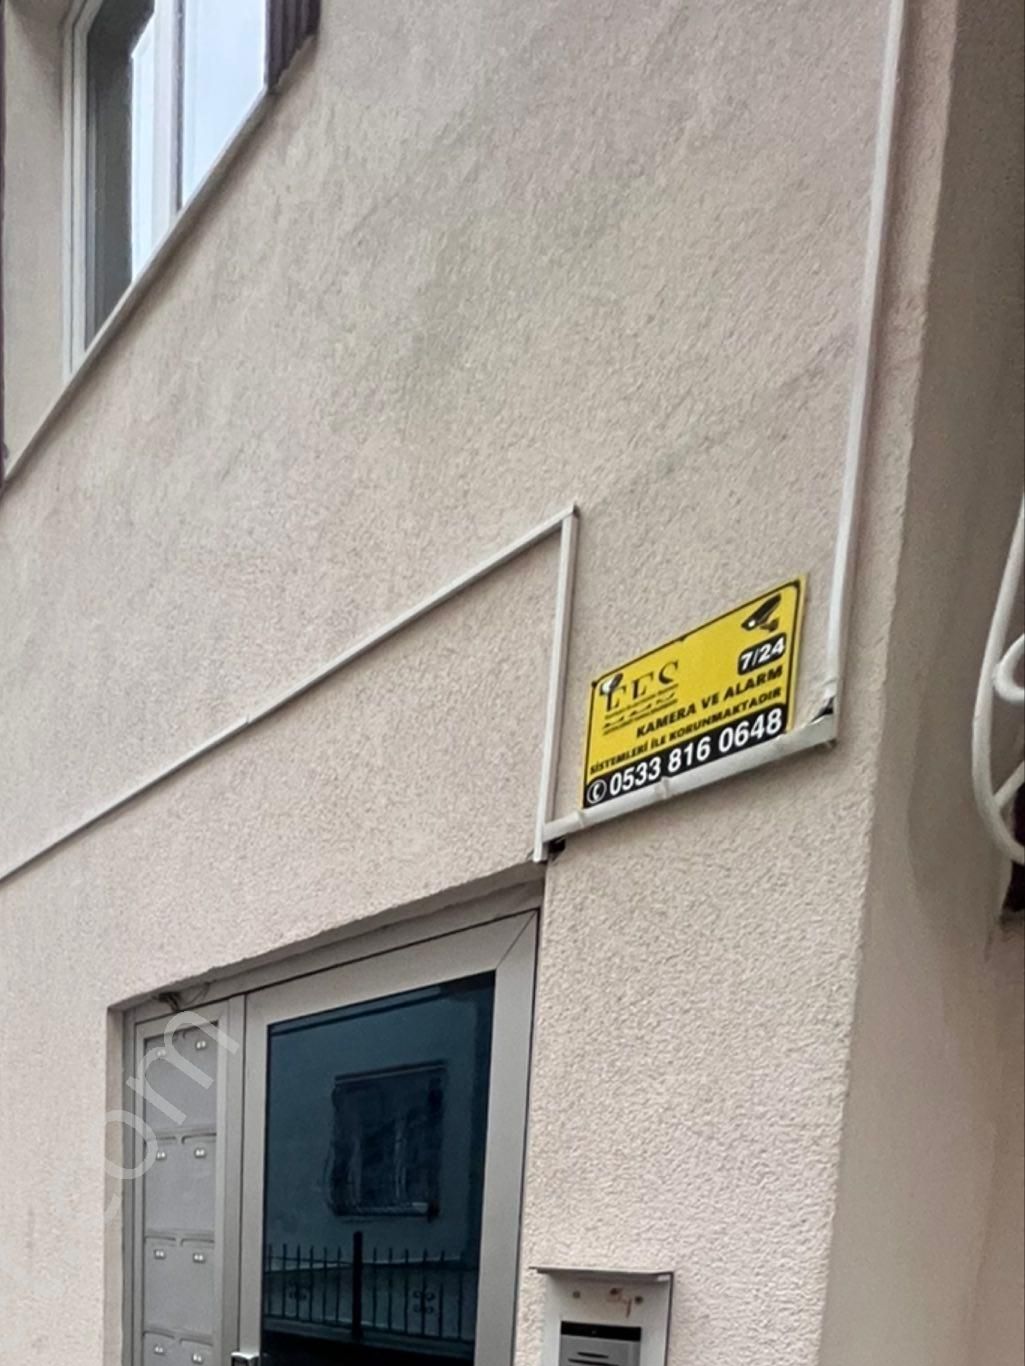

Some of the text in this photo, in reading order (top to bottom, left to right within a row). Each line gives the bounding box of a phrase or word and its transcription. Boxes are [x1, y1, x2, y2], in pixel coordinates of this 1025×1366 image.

[740, 637, 785, 671] 7/24
[636, 703, 697, 738] KAMERA
[701, 692, 720, 710] VE
[723, 665, 783, 701] ALARM
[669, 686, 782, 741] KORUNMAKTADIR
[609, 756, 662, 796] 0533
[668, 735, 711, 773] 816
[718, 707, 783, 753] 0648
